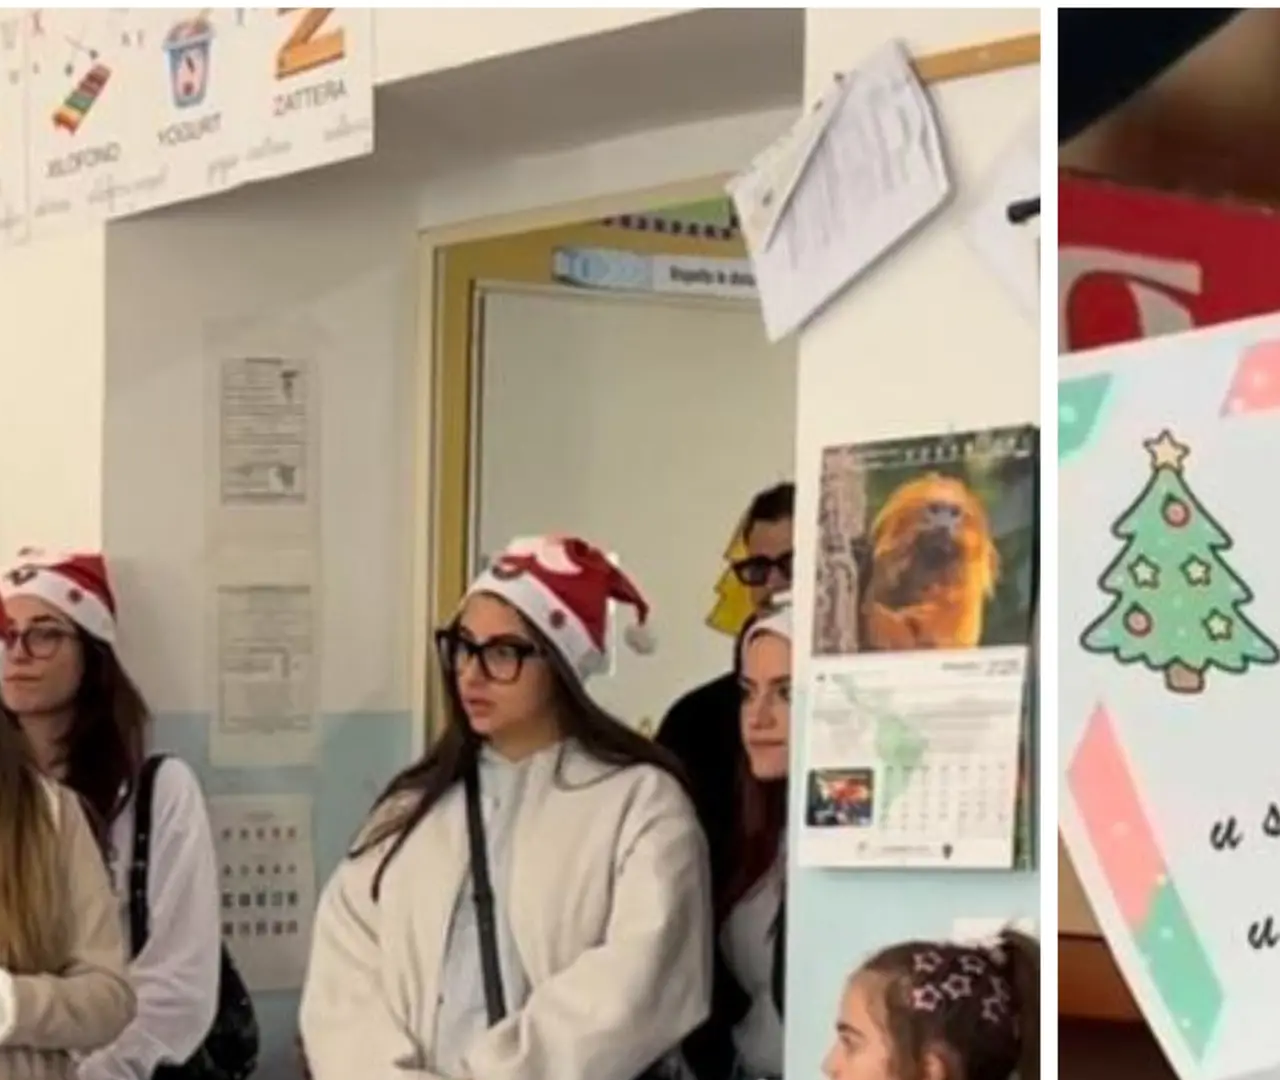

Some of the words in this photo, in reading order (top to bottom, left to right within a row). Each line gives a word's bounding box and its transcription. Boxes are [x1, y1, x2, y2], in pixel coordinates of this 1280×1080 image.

[273, 79, 348, 117] ZATTERA
[1209, 815, 1244, 850] u
[1247, 914, 1280, 949] u
